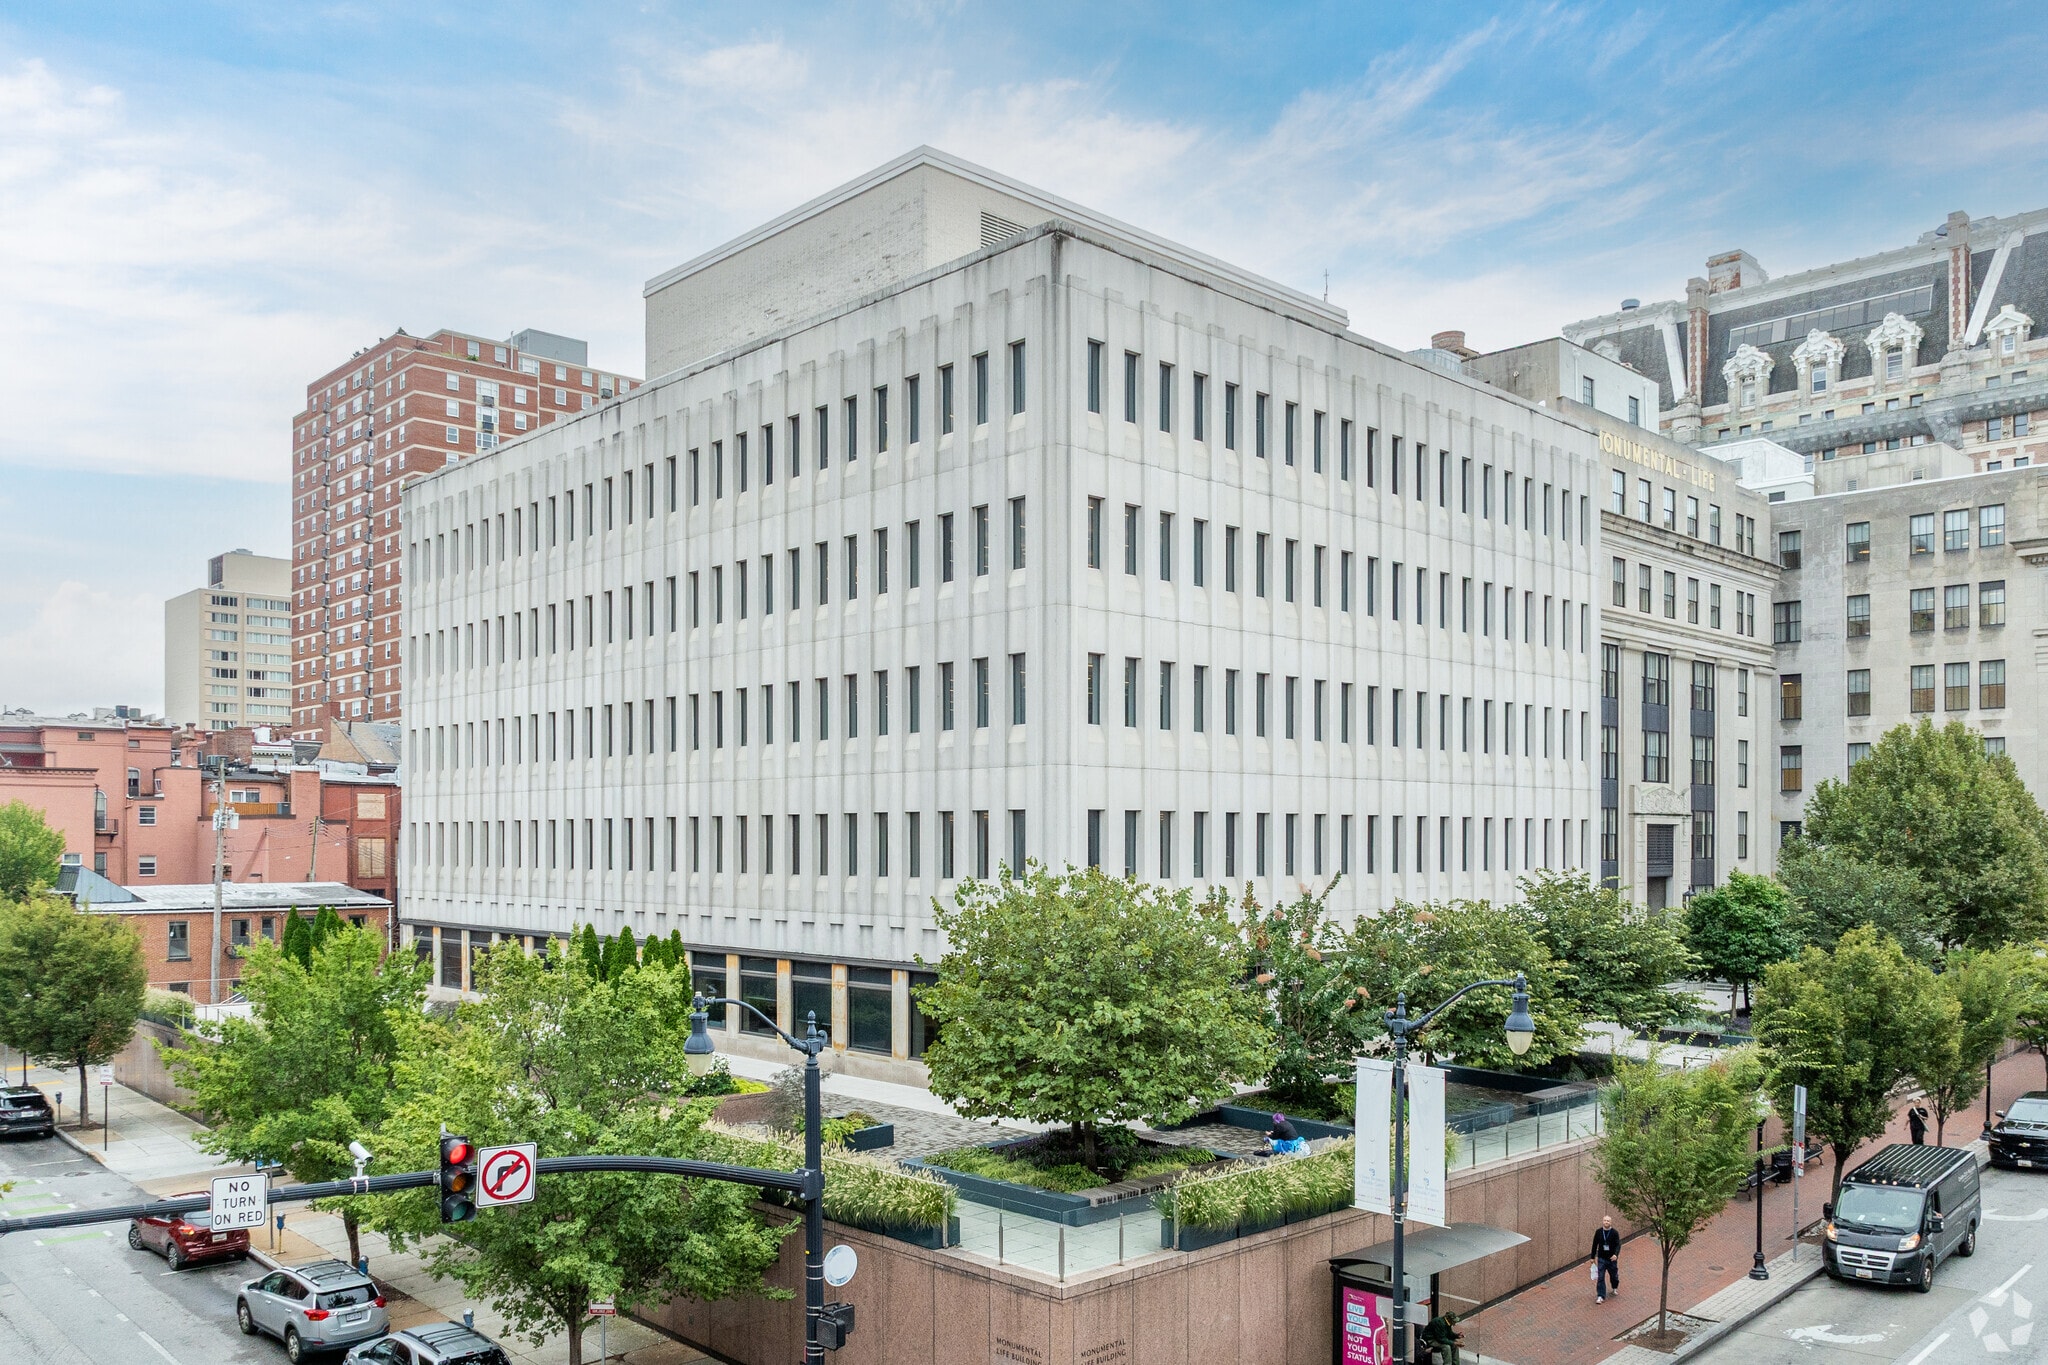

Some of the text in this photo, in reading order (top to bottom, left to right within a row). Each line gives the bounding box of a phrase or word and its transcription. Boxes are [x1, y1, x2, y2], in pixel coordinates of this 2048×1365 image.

[1691, 465, 1716, 493] LIFE
[229, 1181, 250, 1193] NO
[222, 1195, 256, 1209] TURN
[214, 1210, 263, 1225] ON RED
[1348, 1304, 1364, 1314] LIVE
[1348, 1314, 1368, 1325] YOUR
[1347, 1324, 1362, 1334] LIFE
[1347, 1334, 1363, 1344] NOT
[996, 1336, 1042, 1358] MONUMENTAL
[996, 1348, 1010, 1358] LIFE
[1080, 1338, 1126, 1358] MONUMENTAL
[1347, 1343, 1368, 1354] YOUR
[1096, 1349, 1126, 1364] BUILDING
[1347, 1351, 1374, 1364] STATUS.
